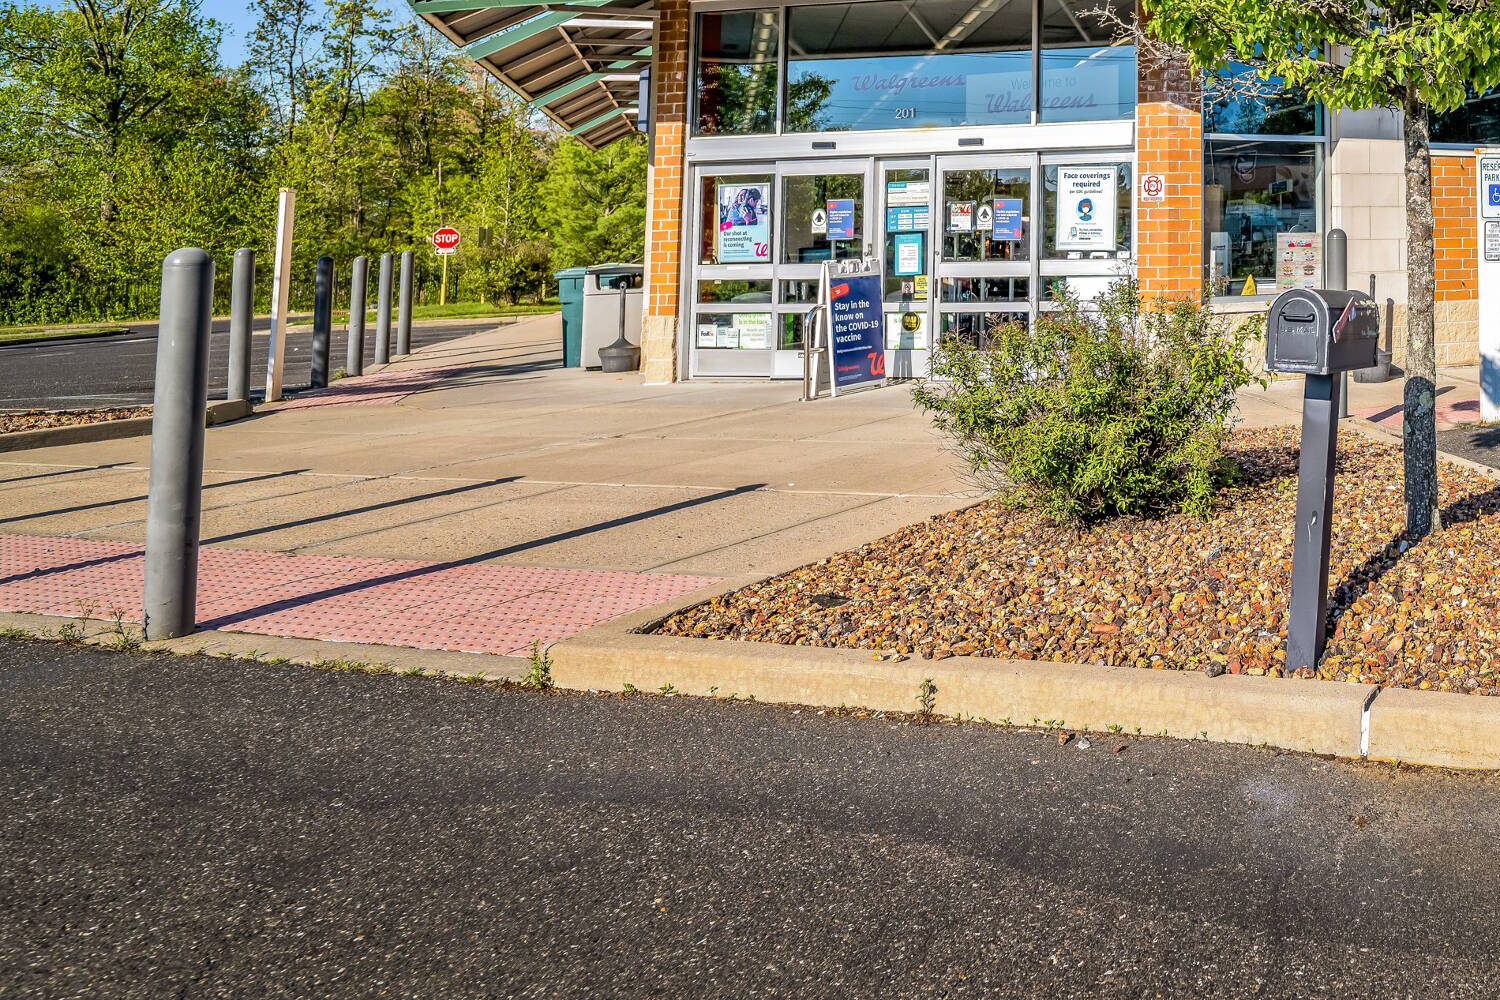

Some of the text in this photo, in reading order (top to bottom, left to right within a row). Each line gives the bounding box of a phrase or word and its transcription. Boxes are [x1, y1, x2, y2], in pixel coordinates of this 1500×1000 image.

[851, 72, 967, 96] Walgreens
[1010, 77, 1062, 90] Welme
[985, 91, 1098, 113] Walreens
[895, 107, 916, 119] 201
[1063, 172, 1111, 181] Face coverings
[1072, 180, 1101, 188] required
[435, 233, 458, 243] STOP
[834, 299, 870, 311] Stay in the
[834, 312, 864, 322] know on
[835, 323, 848, 333] the
[848, 320, 879, 331] COVID-19
[836, 333, 862, 343] vaccine
